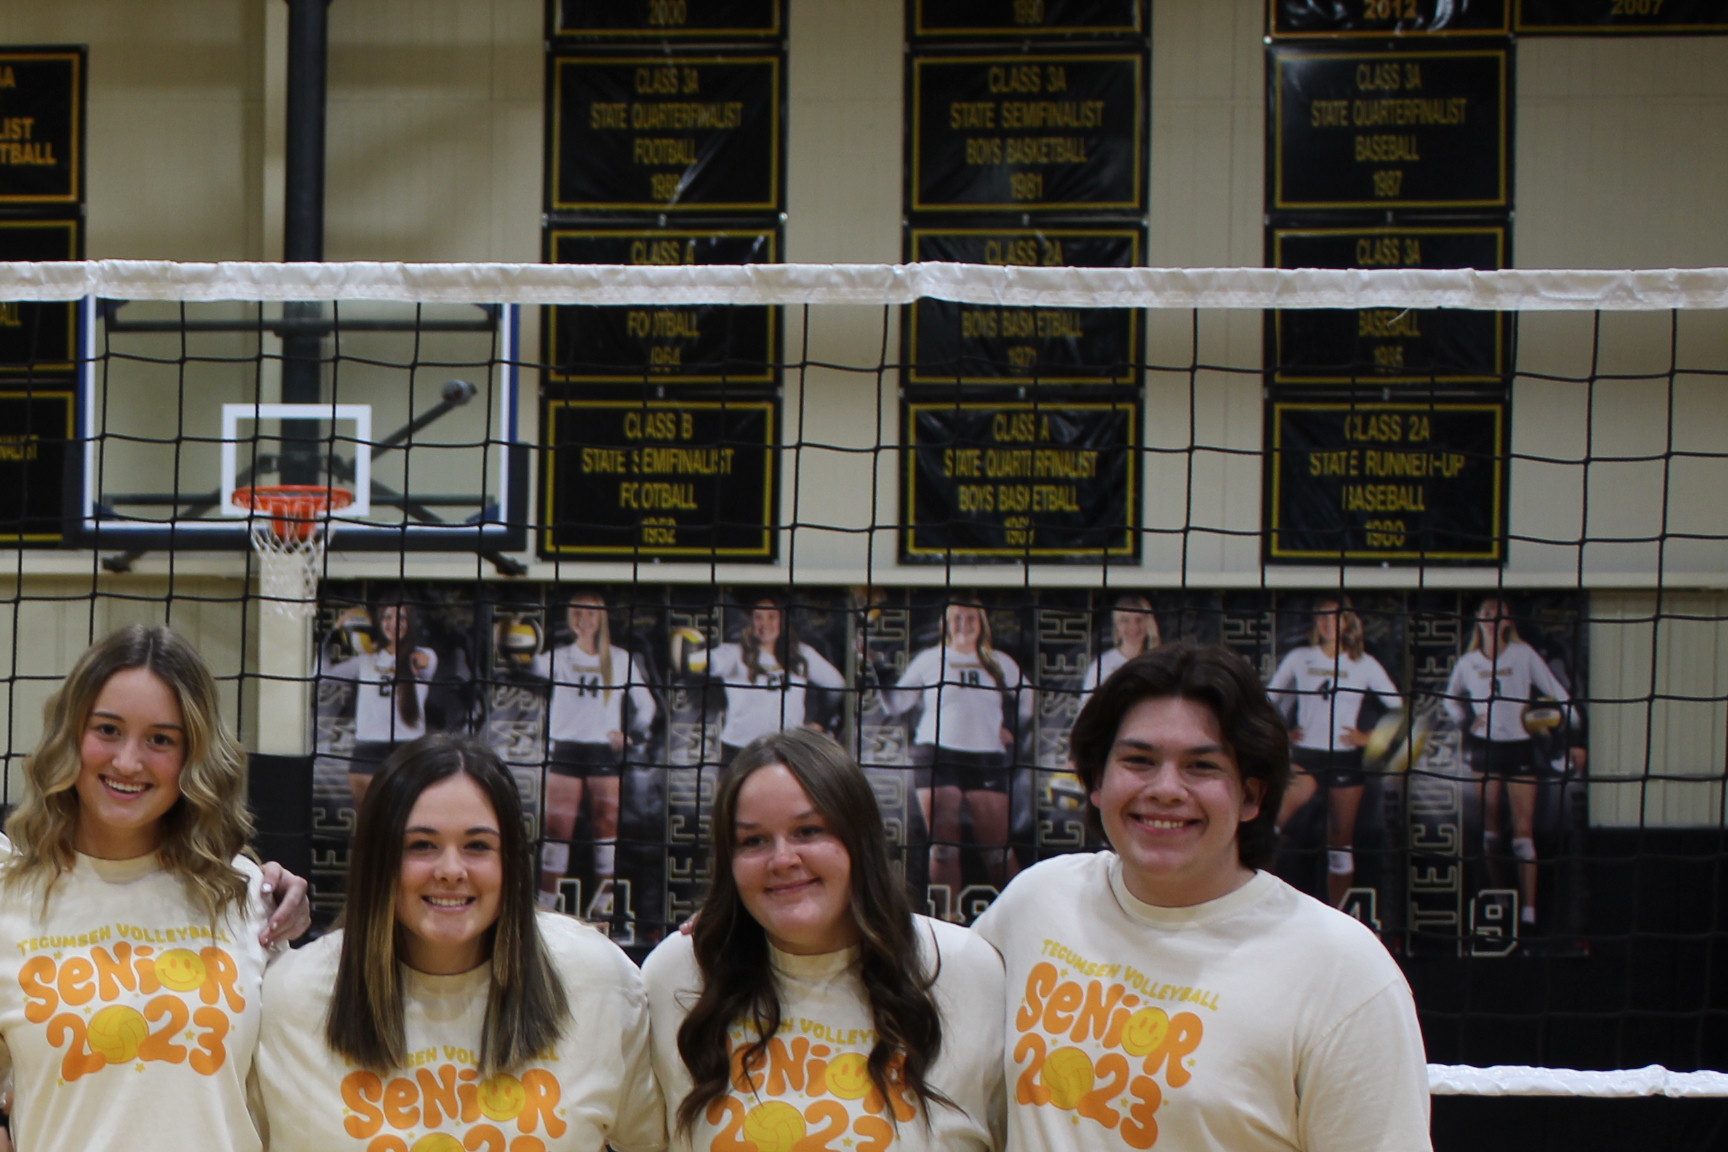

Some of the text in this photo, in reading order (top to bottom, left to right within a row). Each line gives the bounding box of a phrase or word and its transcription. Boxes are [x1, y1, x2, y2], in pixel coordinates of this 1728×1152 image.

[635, 69, 678, 94] CLASS
[989, 66, 1040, 93] CLASS
[1357, 63, 1400, 90] CLASS
[591, 102, 743, 129] STATE QUARTERFINALIST
[950, 101, 1104, 129] STATE SEMIFINALIST
[1311, 98, 1467, 127] STATE QUARTERFINALIST
[633, 138, 698, 165] FOOTBALL
[966, 137, 1087, 164] BOYS BASKETBALL
[1355, 135, 1419, 162] BASEBALL
[631, 241, 679, 264] CLASS
[985, 240, 1038, 266] CLASS
[1356, 239, 1400, 265] CLASS
[627, 311, 700, 337] FOOTBALL
[962, 311, 1083, 338] BOYS BASKETBALL
[624, 413, 675, 439] CLASS
[993, 414, 1035, 441] CLASS
[1344, 416, 1402, 441] CLASS
[582, 448, 626, 474] STATE
[944, 450, 981, 477] STATE
[1310, 451, 1359, 477] STATE
[620, 482, 698, 509] FOOTBALL
[959, 486, 995, 512] BOYS
[555, 878, 636, 946] 14
[17, 922, 232, 955] TECUMSEH VOLLEYBALL
[1042, 938, 1221, 1012] TECUMSEH VOLLEYBALL
[46, 994, 229, 1082] 2023
[1014, 1032, 1162, 1150] 2023
